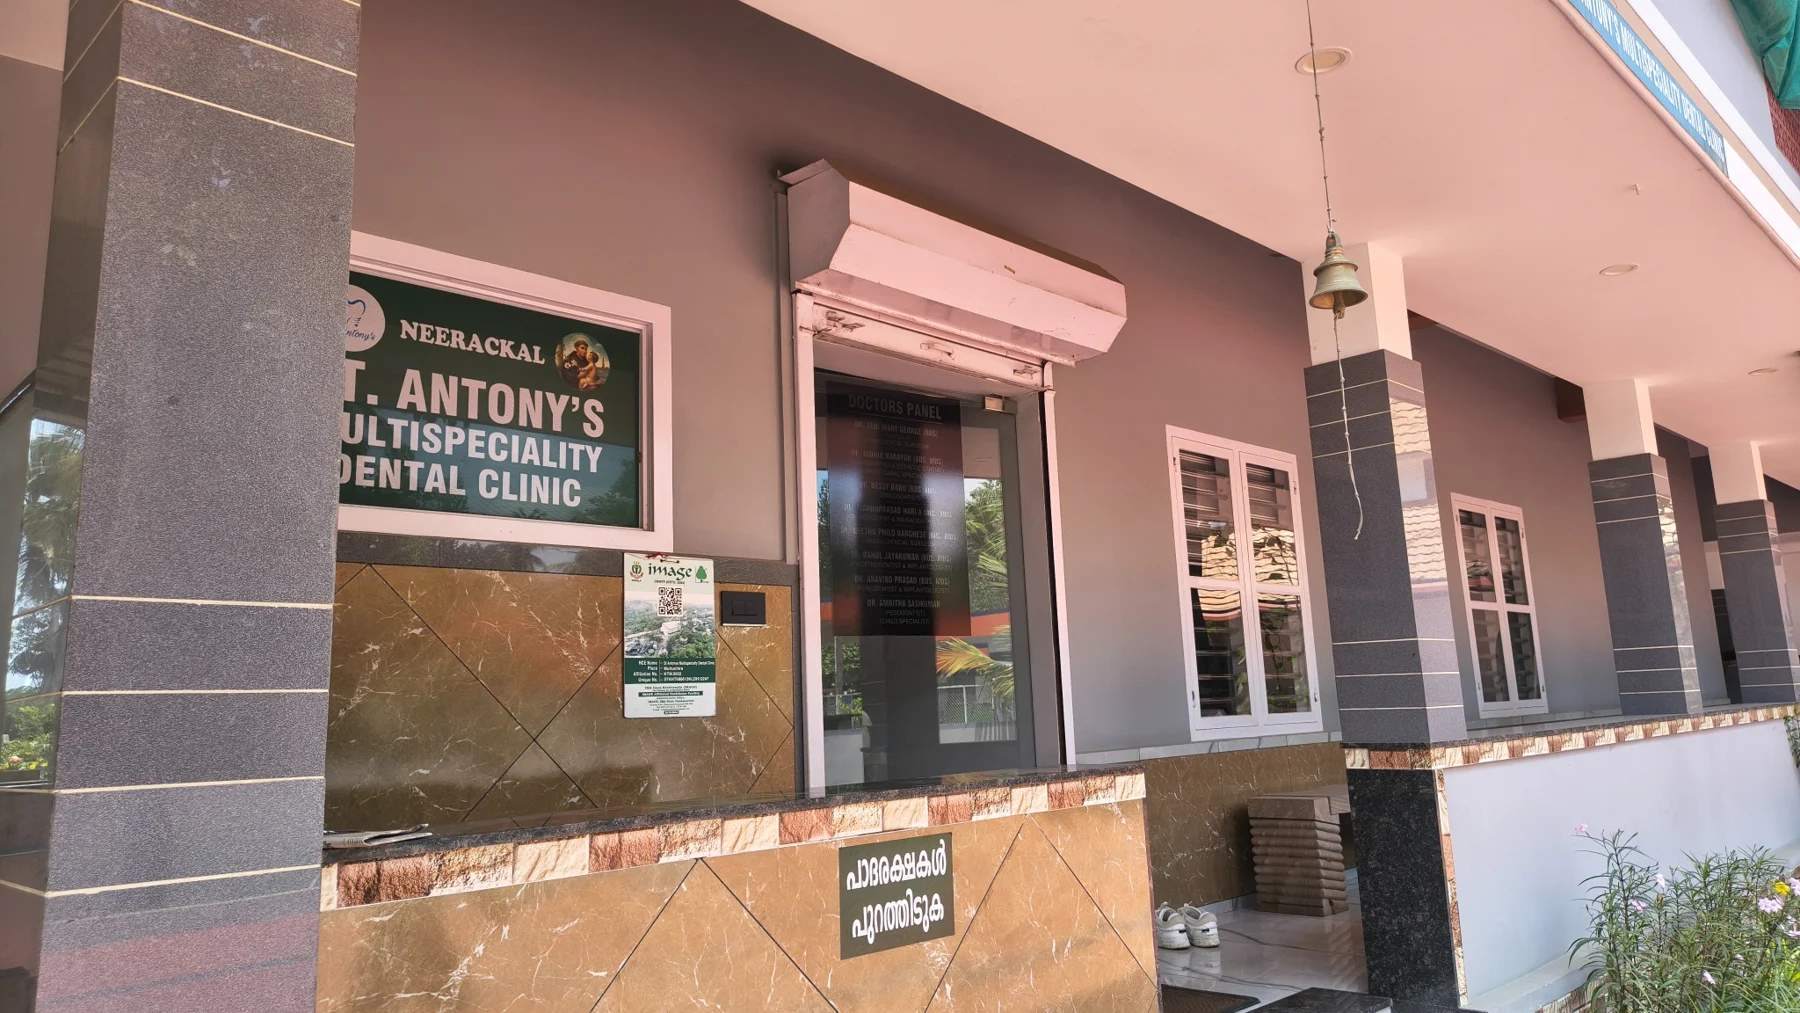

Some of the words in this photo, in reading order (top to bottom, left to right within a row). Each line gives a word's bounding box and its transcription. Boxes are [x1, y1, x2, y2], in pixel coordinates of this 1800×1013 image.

[1581, 0, 1620, 46] TONY'S
[1680, 93, 1706, 141] DENTAL
[345, 329, 376, 342] ntony's
[399, 319, 546, 365] NEERACKAL
[344, 358, 379, 405] T.
[396, 368, 606, 438] ANTONY'S
[848, 394, 903, 415] DOCTORS
[906, 402, 942, 420] PANEL
[341, 411, 603, 474] ULTISPECIALITY
[899, 426, 922, 436] GEORGE
[338, 453, 467, 496] DENTAL
[478, 468, 582, 508] CLINIC
[648, 562, 692, 581] image
[894, 576, 918, 584] PRASAD
[867, 599, 878, 607] DR.
[879, 599, 907, 607] AMRITHA
[907, 600, 941, 608] SASIKUMAR
[846, 839, 947, 890] പാദരക്ഷകൾ
[852, 888, 944, 945] പുറത്തിടുക
